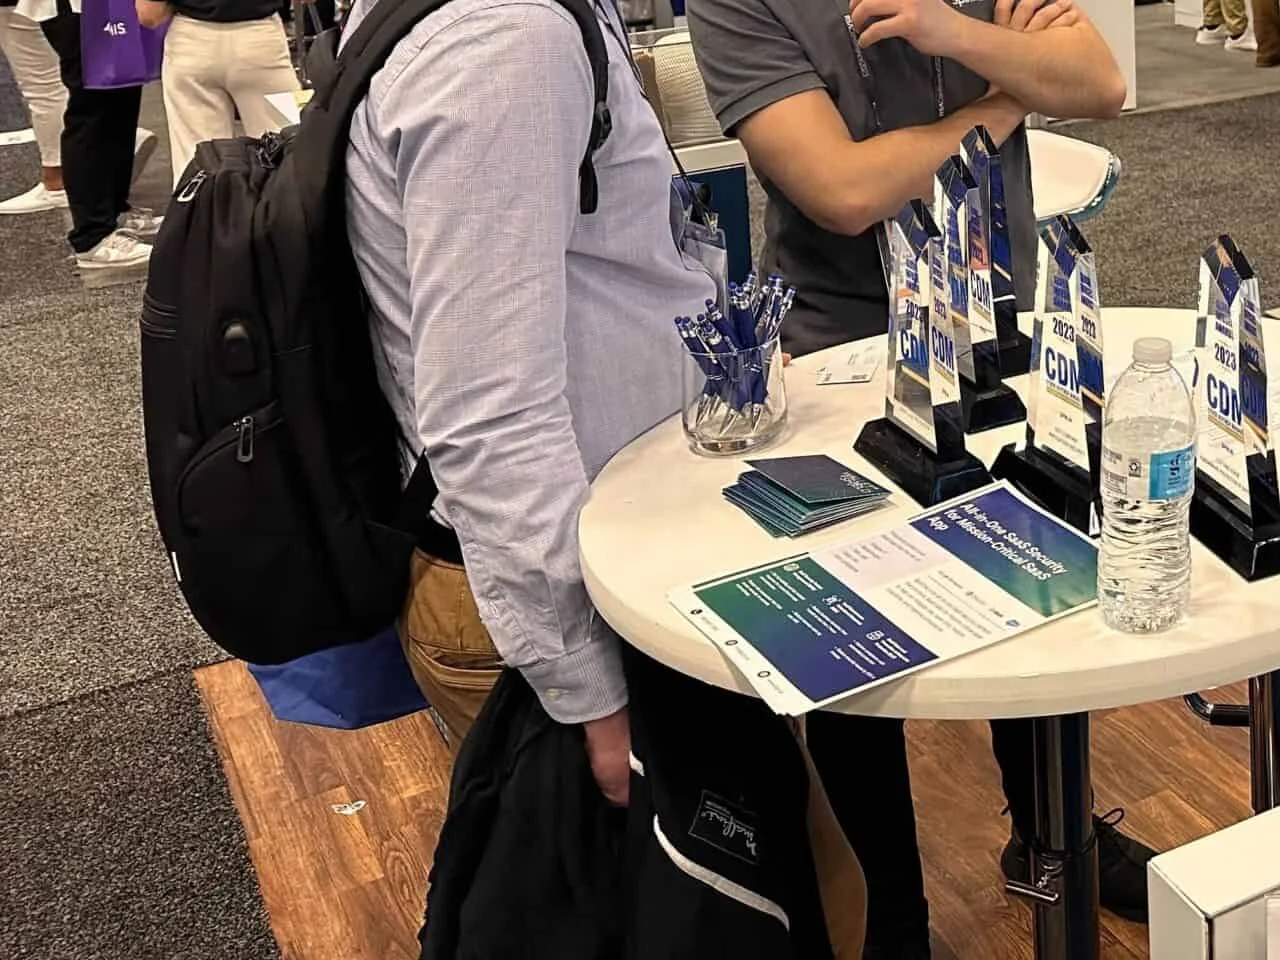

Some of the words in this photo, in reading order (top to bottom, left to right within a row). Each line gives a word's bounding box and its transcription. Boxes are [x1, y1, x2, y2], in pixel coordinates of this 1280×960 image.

[931, 325, 955, 373] CDM
[1053, 317, 1075, 343] 2023
[1214, 343, 1237, 372] 2023
[926, 516, 949, 531] App
[960, 503, 1006, 535] All-in-One
[1004, 532, 1030, 550] SaaS
[1026, 546, 1068, 574] Security
[944, 509, 961, 521] for
[958, 518, 1025, 565] Mission-Critical
[1022, 562, 1051, 581] SaaS
